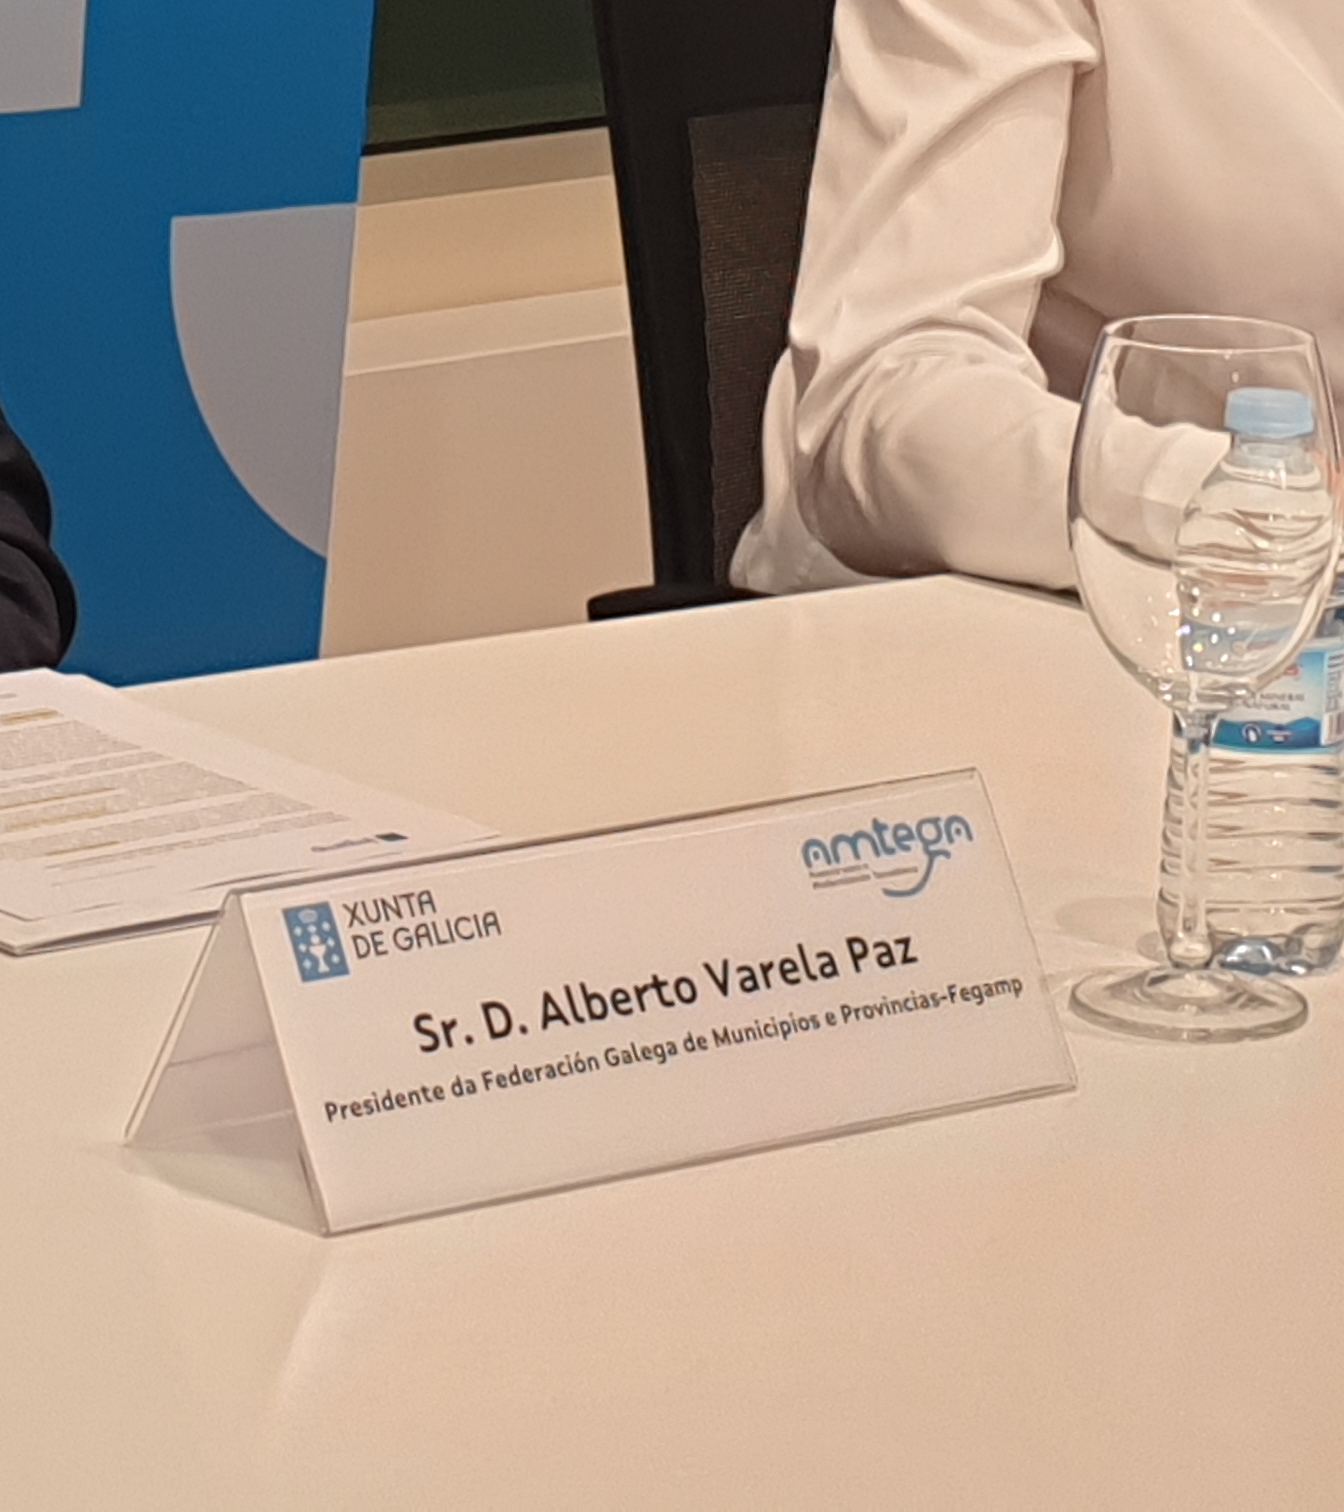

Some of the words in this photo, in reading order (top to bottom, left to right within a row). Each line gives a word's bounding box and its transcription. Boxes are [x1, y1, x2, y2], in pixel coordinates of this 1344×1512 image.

[342, 889, 436, 928] XUNTA
[351, 930, 388, 959] DE
[392, 910, 501, 951] GALICIA
[413, 1013, 473, 1052] Sr.
[481, 1001, 527, 1039] D.
[541, 974, 697, 1030] Alberto
[702, 943, 838, 996] Varela
[845, 936, 917, 973] Paz
[324, 1085, 444, 1122] Presidente
[451, 1075, 477, 1097] da
[481, 1051, 599, 1090] Federación
[604, 1041, 677, 1067] Galega
[683, 1031, 707, 1052] de
[711, 1012, 820, 1047] Municipios
[824, 1012, 836, 1026] e
[840, 978, 1022, 1023] Provincias-Fegamp
